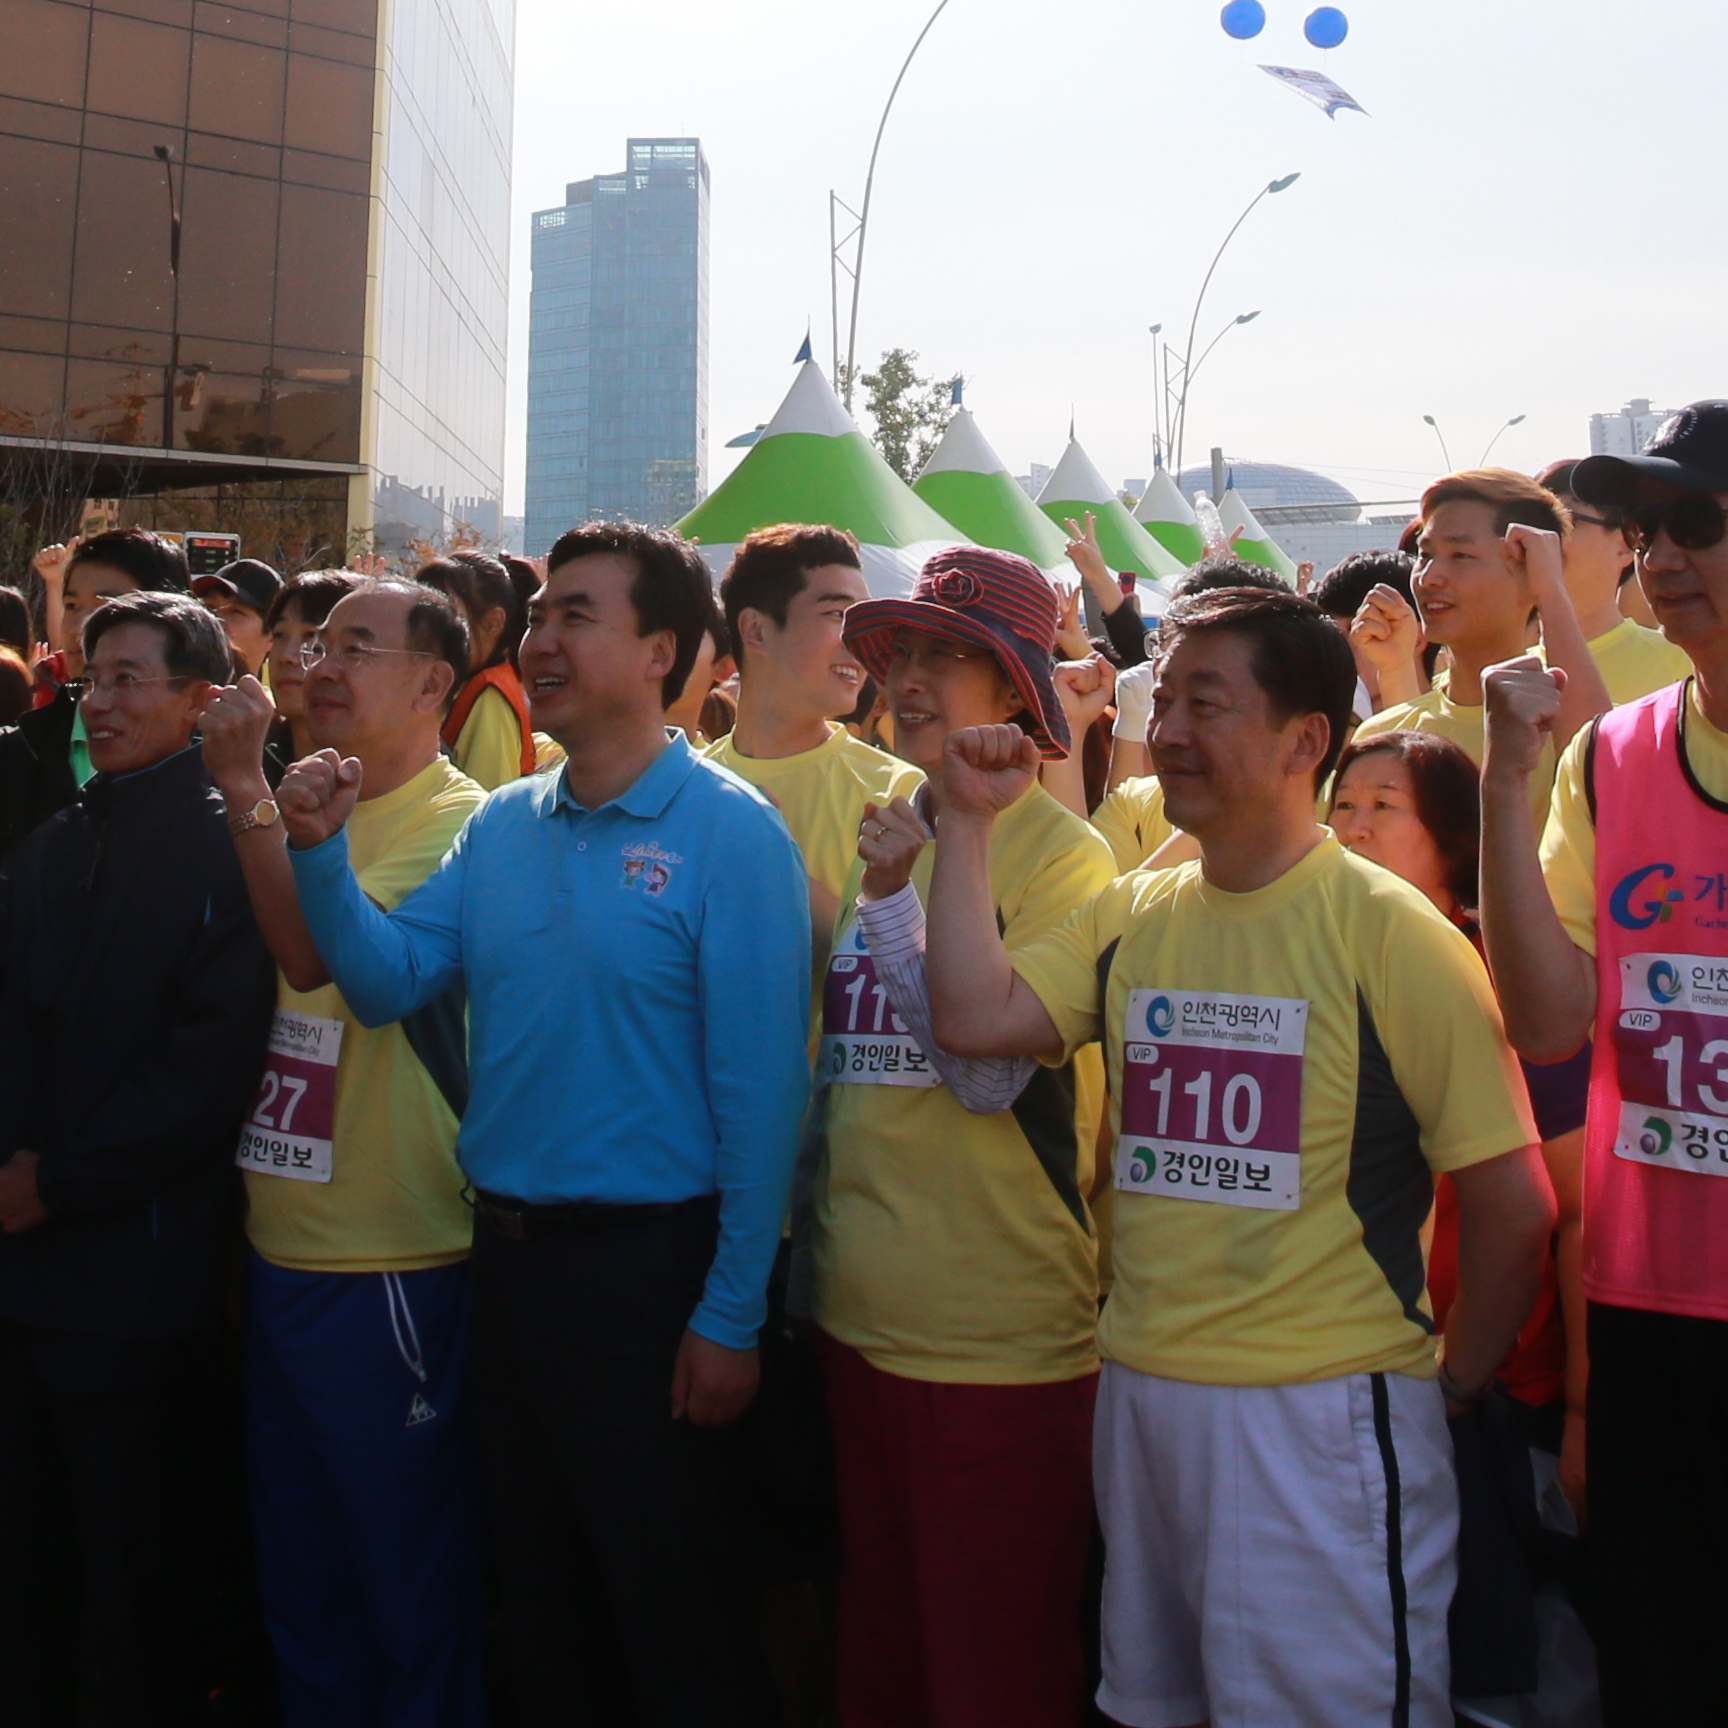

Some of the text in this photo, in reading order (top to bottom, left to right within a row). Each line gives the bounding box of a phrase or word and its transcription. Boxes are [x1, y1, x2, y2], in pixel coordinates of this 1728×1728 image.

[836, 959, 852, 969] VIP
[845, 974, 910, 1032] 11
[1183, 1001, 1280, 1030] 인천광역시
[1629, 1013, 1653, 1027] VIP
[1211, 1029, 1261, 1043] Metropolitan
[1263, 1033, 1279, 1046] City
[850, 1044, 928, 1072] 경인일보
[1132, 1047, 1151, 1060] VIP
[1149, 1068, 1262, 1145] 110
[240, 1132, 313, 1169] 경인일보
[1162, 1150, 1272, 1192] 경인일보
